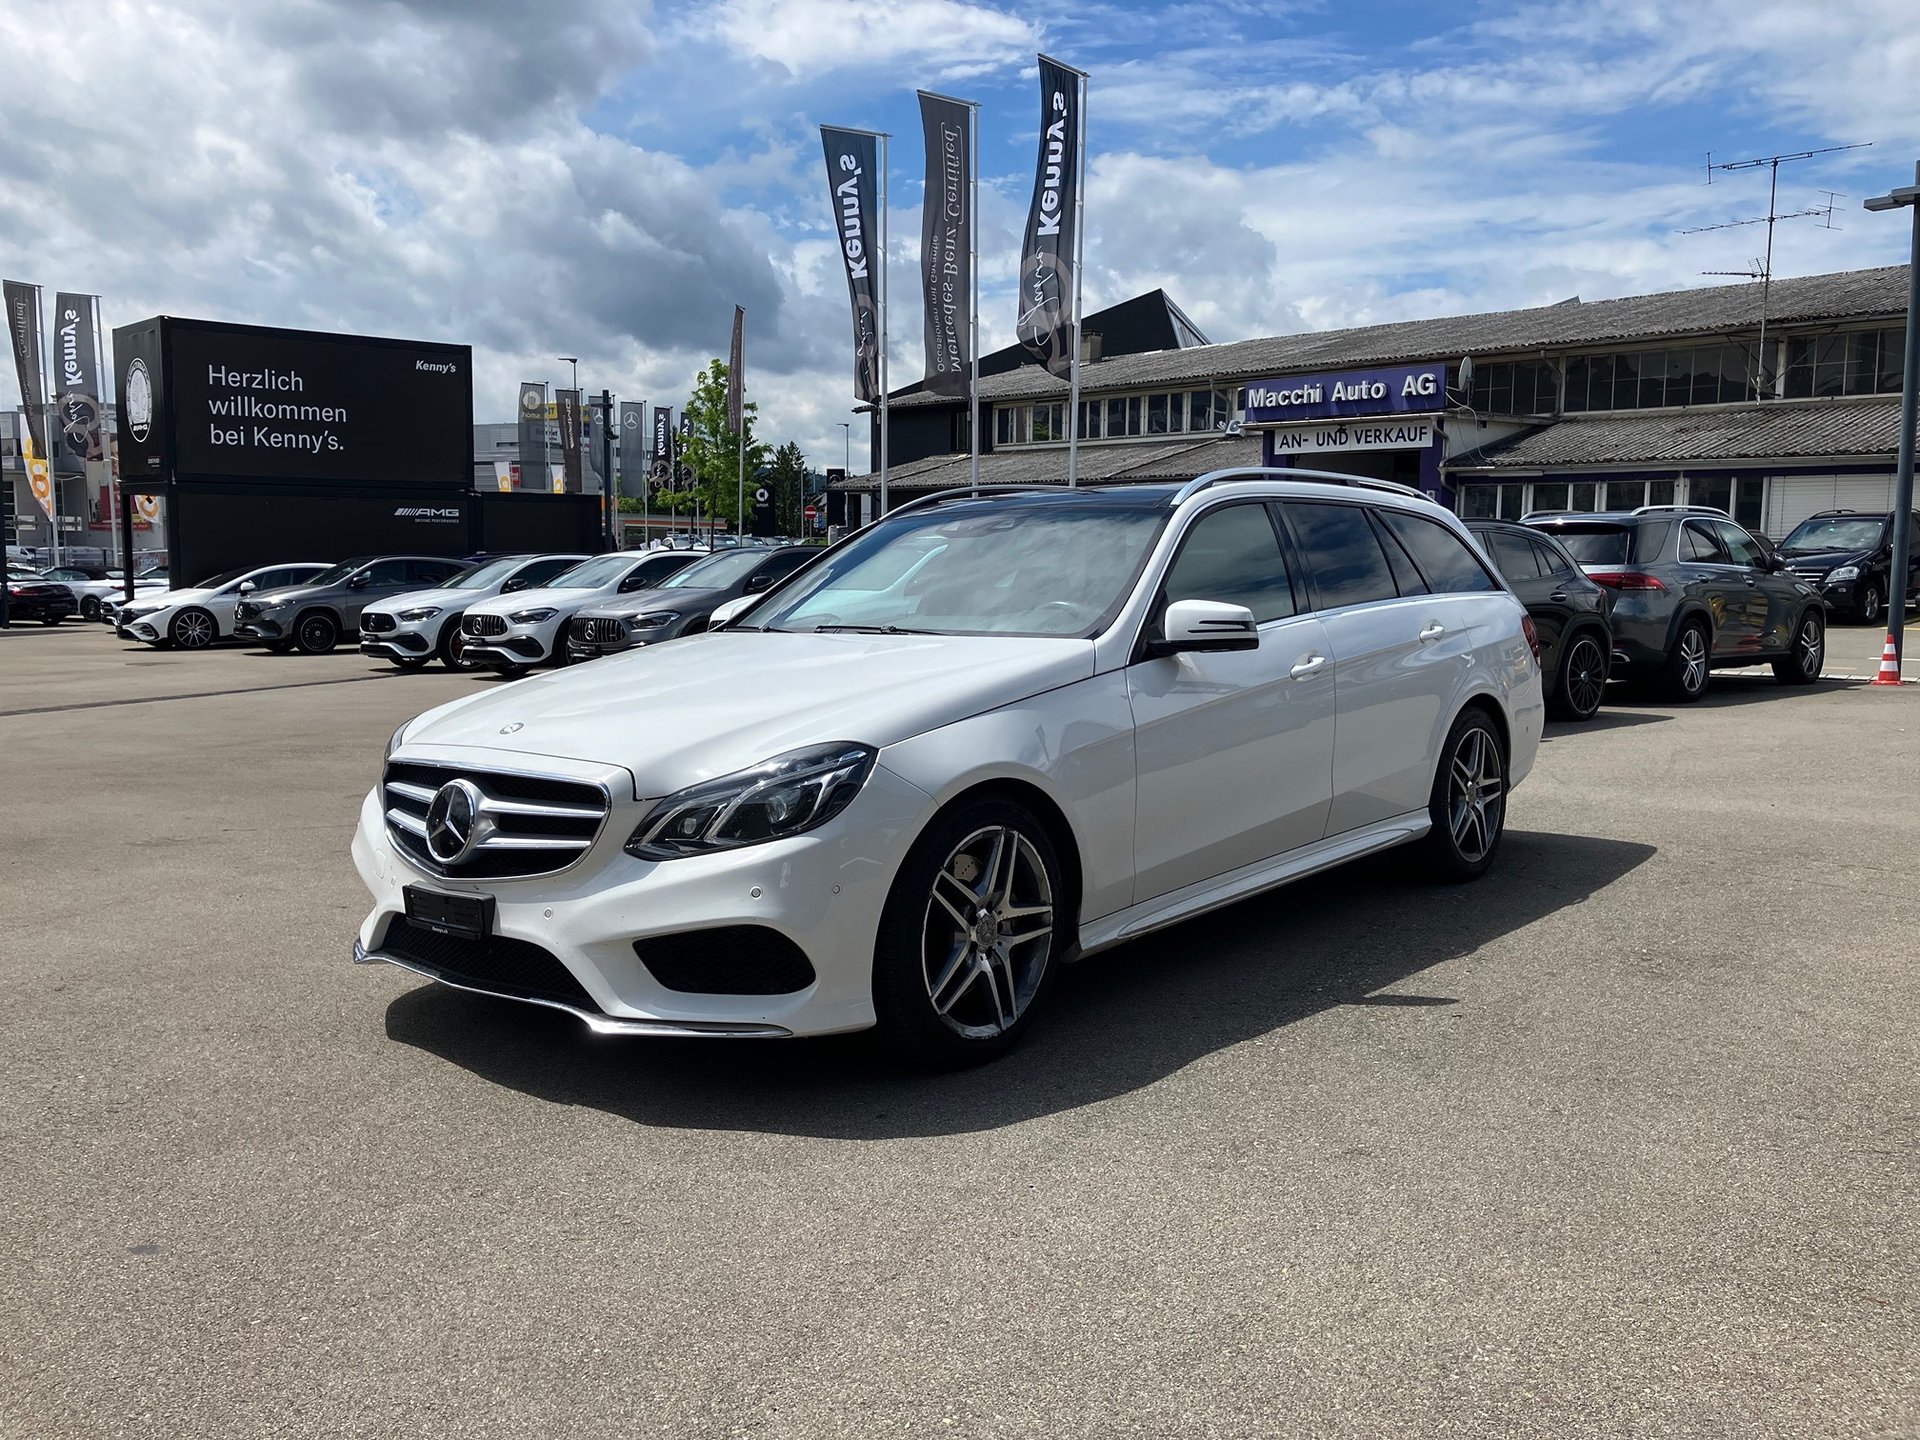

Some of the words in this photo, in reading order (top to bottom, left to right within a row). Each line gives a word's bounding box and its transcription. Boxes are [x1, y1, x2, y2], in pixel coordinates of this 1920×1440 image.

[208, 364, 304, 392] Herzlich
[415, 360, 457, 375] Kenny's
[1248, 383, 1324, 409] Macchi
[1331, 380, 1388, 402] Auto
[1401, 373, 1437, 396] AG
[208, 396, 347, 423] willkommen
[210, 423, 245, 446] bei
[254, 426, 344, 454] Kenny's.
[1279, 433, 1309, 449] AN-
[1316, 429, 1349, 447] UND
[1354, 426, 1428, 445] VERKAUF
